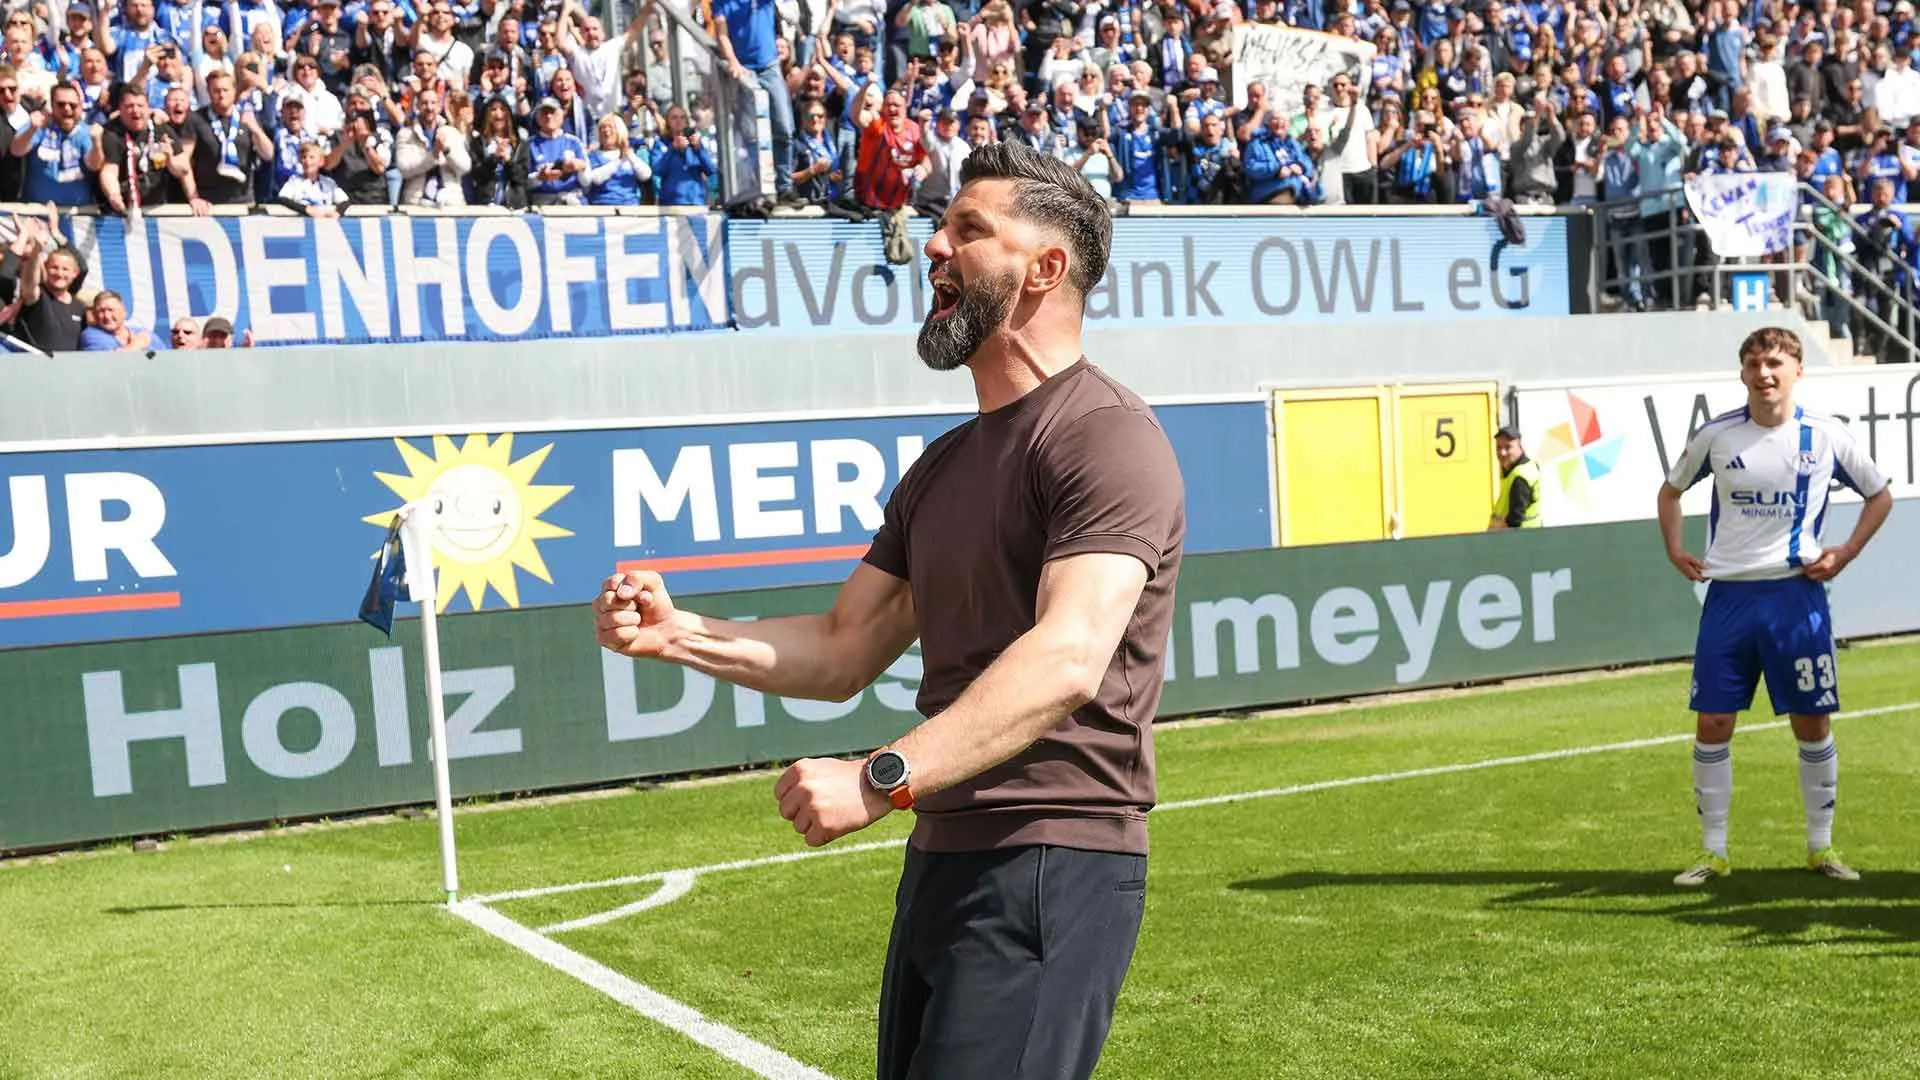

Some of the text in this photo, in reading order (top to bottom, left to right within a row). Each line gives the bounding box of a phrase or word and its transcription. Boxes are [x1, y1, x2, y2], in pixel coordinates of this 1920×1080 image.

[1250, 236, 1425, 315] OWL
[1447, 238, 1530, 310] eG
[1737, 279, 1765, 312] H
[1434, 418, 1457, 459] 5
[1730, 490, 1805, 506] SUN
[1794, 653, 1836, 692] 33
[82, 645, 523, 798] Holz
